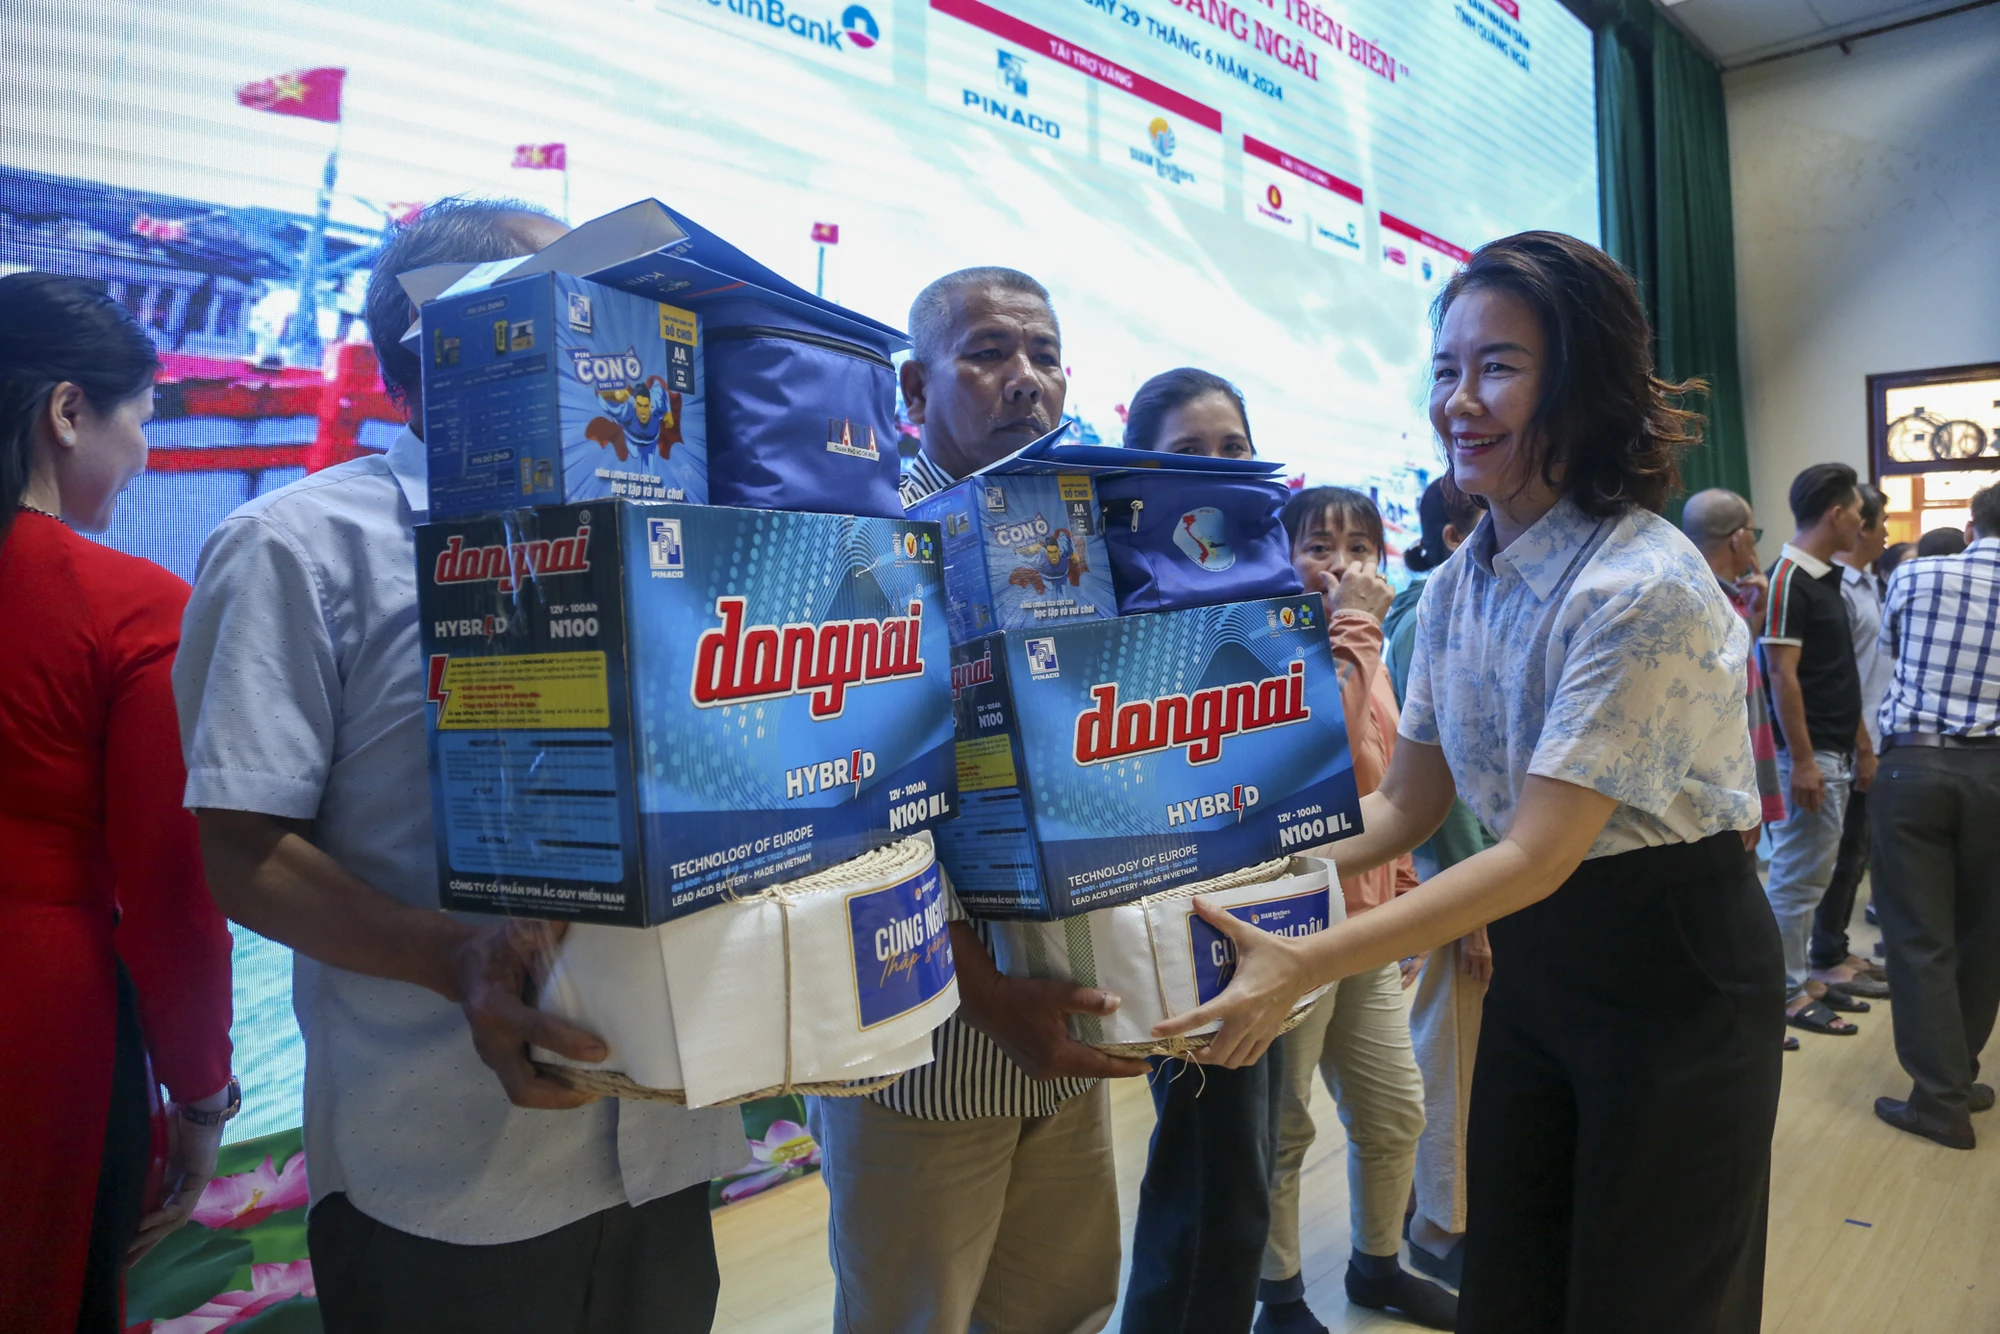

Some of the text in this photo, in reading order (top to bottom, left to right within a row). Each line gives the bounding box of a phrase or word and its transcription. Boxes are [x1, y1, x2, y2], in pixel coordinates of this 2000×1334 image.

[1121, 5, 1283, 100] 29 THÁNG 6 NĂM 2024
[962, 88, 1061, 140] PINACO
[674, 346, 686, 361] AA
[611, 480, 626, 497] học
[628, 483, 641, 498] tập
[643, 484, 652, 497] và
[654, 486, 666, 498] vui
[1074, 503, 1085, 513] AA
[434, 525, 591, 594] dongnai
[651, 571, 684, 579] PINACO
[1060, 606, 1068, 616] và
[1069, 605, 1079, 615] vui
[551, 617, 598, 639] N100
[690, 596, 924, 722] dongnai
[1032, 672, 1060, 681] PINACO
[979, 711, 1003, 728] N100
[1073, 659, 1311, 767] dongnai
[889, 780, 927, 801] 12V 100Ah
[1277, 804, 1322, 824] 12V 100Ah
[670, 824, 814, 880] TECHNOLOGY OF EUROPE
[1068, 844, 1198, 887] TECHNOLOGY OF EUROPE
[671, 883, 684, 893] ISO
[672, 853, 812, 907] LEAD ACID BATTERY MADE IN VIETNAM
[1072, 895, 1091, 906] LEAD
[1092, 890, 1108, 901] ACID
[1109, 882, 1138, 895] BATTERY
[1143, 875, 1162, 887] MADE
[1169, 865, 1198, 878] VIETNAM
[1082, 884, 1095, 894] 9001
[1099, 880, 1112, 889] IATF
[450, 879, 473, 891] CÔNG
[473, 883, 485, 892] TY
[486, 881, 498, 893] CỔ
[500, 881, 525, 896] PHẦN
[526, 886, 541, 896] PIN
[557, 888, 576, 899] QUY
[578, 887, 601, 902] MIỀN
[602, 892, 624, 904] NAM
[1261, 912, 1272, 920] SIAM
[875, 913, 923, 962] CÙNG
